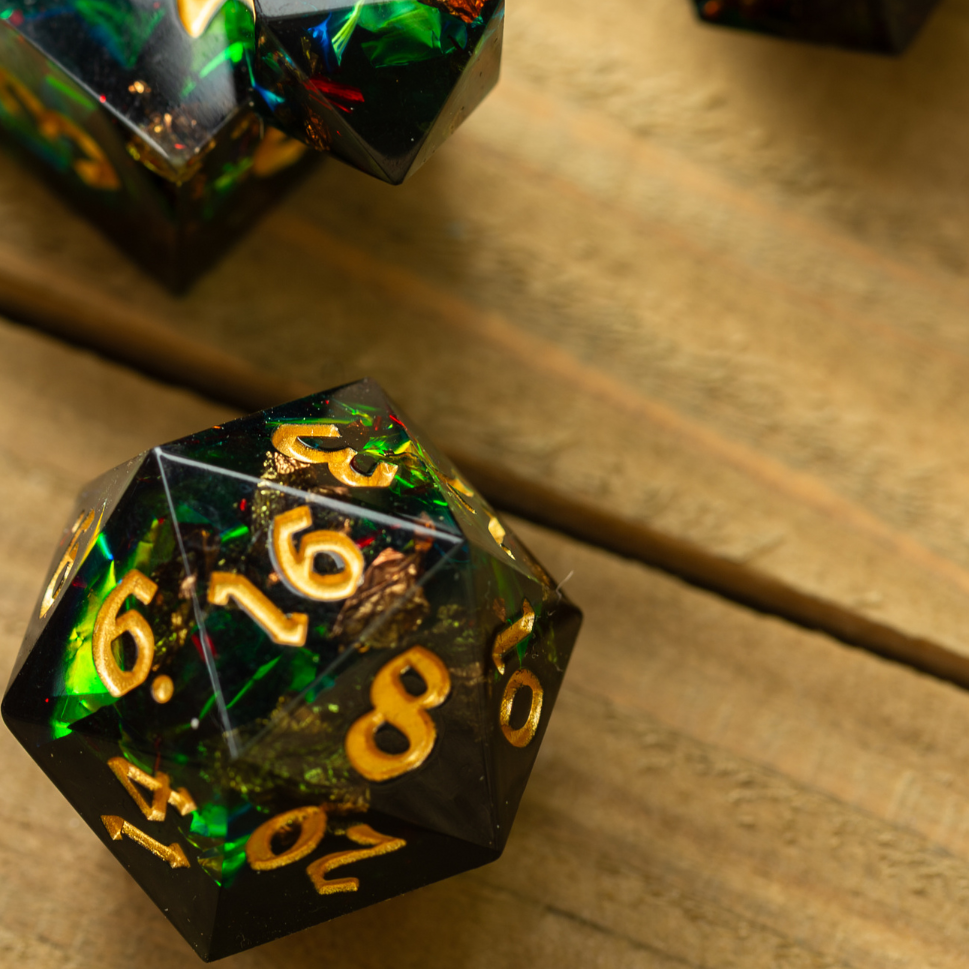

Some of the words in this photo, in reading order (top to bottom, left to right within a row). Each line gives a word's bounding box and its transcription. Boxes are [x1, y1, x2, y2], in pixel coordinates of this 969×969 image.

[271, 423, 399, 488] 3
[208, 505, 366, 647] 16
[345, 644, 452, 782] 8
[492, 598, 544, 748] 10
[101, 756, 197, 869] 14
[245, 805, 408, 895] 20
